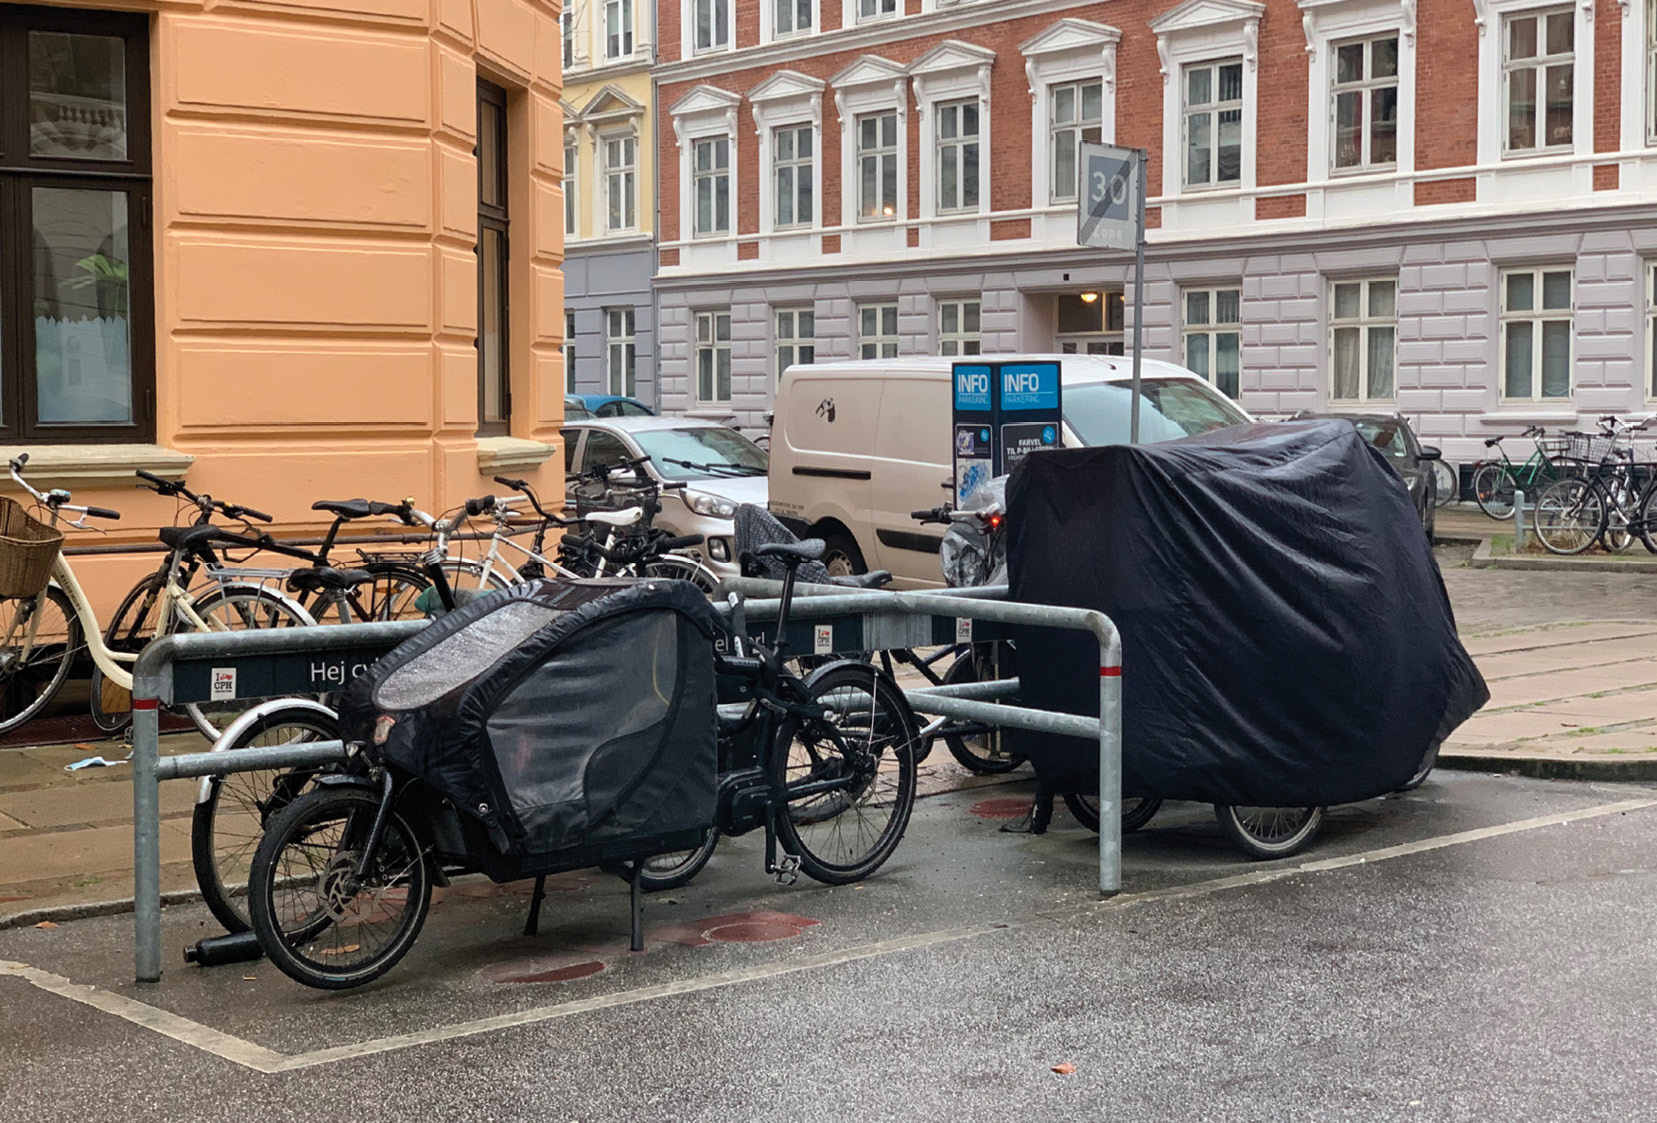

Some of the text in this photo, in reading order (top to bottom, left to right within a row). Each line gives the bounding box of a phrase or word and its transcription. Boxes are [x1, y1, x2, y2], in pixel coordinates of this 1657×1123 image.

[1092, 171, 1127, 205] 30
[957, 374, 988, 393] INFO
[1004, 373, 1039, 392] INFO
[958, 395, 989, 404] PARKERING
[1004, 394, 1040, 404] PARKERING
[1018, 438, 1042, 446] FARVEL
[1006, 447, 1016, 455] TIL
[311, 660, 345, 685] Hej
[214, 681, 232, 690] CPH
